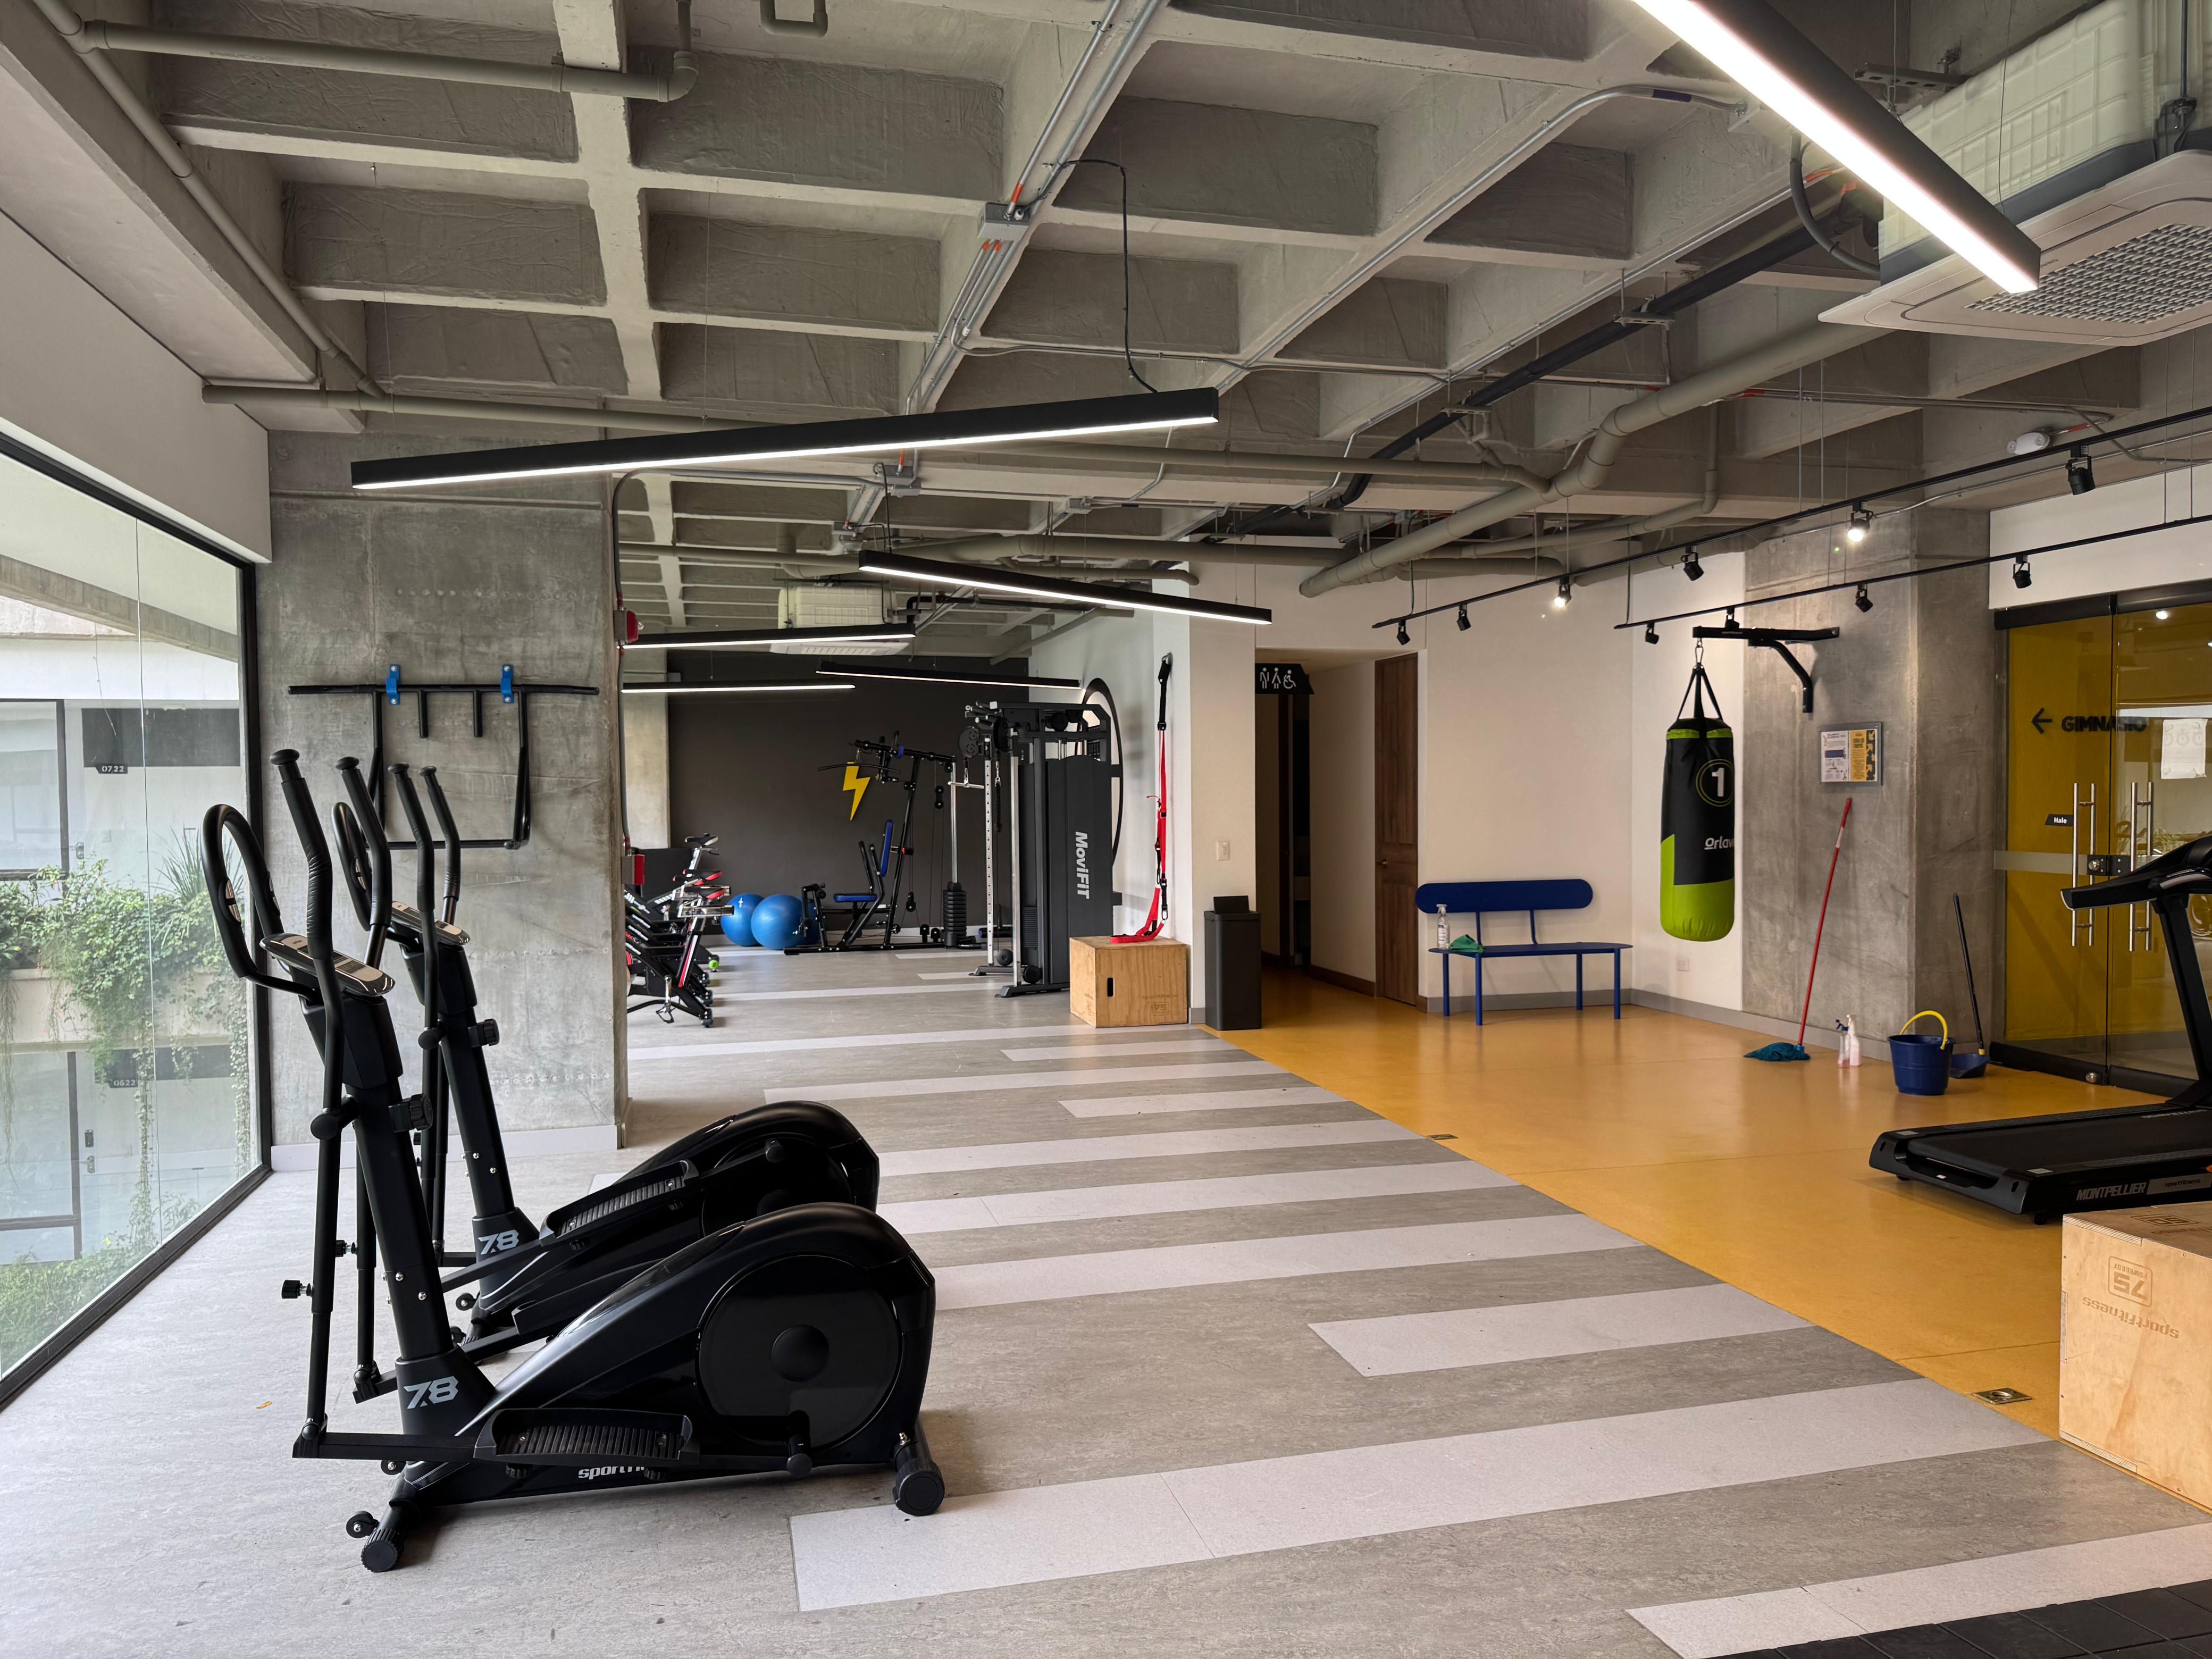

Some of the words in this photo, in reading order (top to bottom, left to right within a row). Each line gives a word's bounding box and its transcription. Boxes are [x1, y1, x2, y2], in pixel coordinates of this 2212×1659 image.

[2062, 716, 2147, 732] GIMNASIO
[1712, 767, 1725, 797] 1
[2076, 1182, 2147, 1201] MONTPELLIER
[2114, 1271, 2148, 1301] 75
[2082, 1296, 2180, 1339] sportfitness
